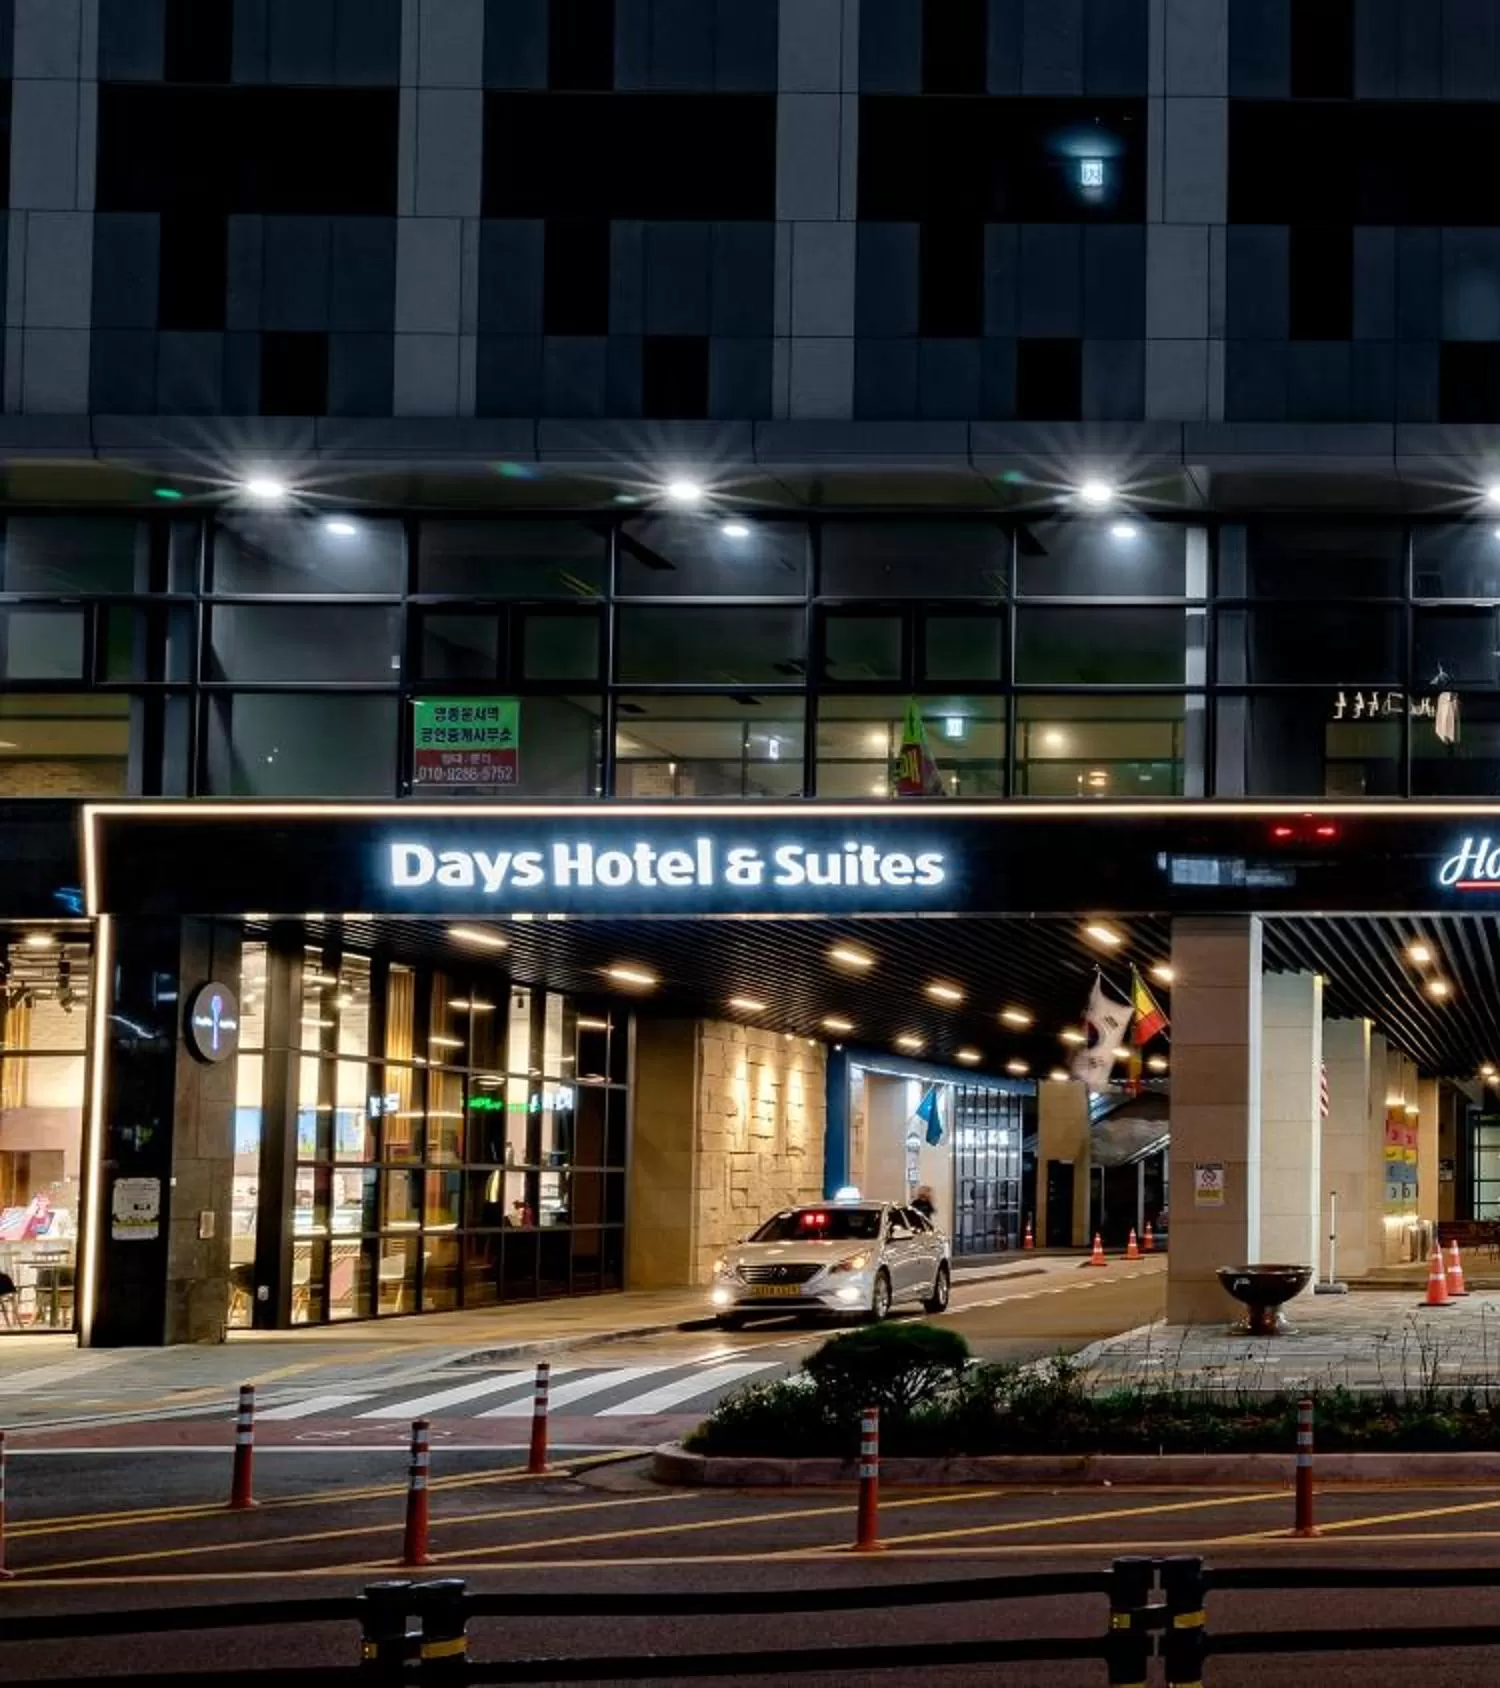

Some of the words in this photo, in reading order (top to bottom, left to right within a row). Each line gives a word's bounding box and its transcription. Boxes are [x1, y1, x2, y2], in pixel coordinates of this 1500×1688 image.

[390, 843, 544, 892] Days
[553, 838, 714, 887] Hotel
[724, 848, 764, 886] &
[773, 842, 946, 887] Suites
